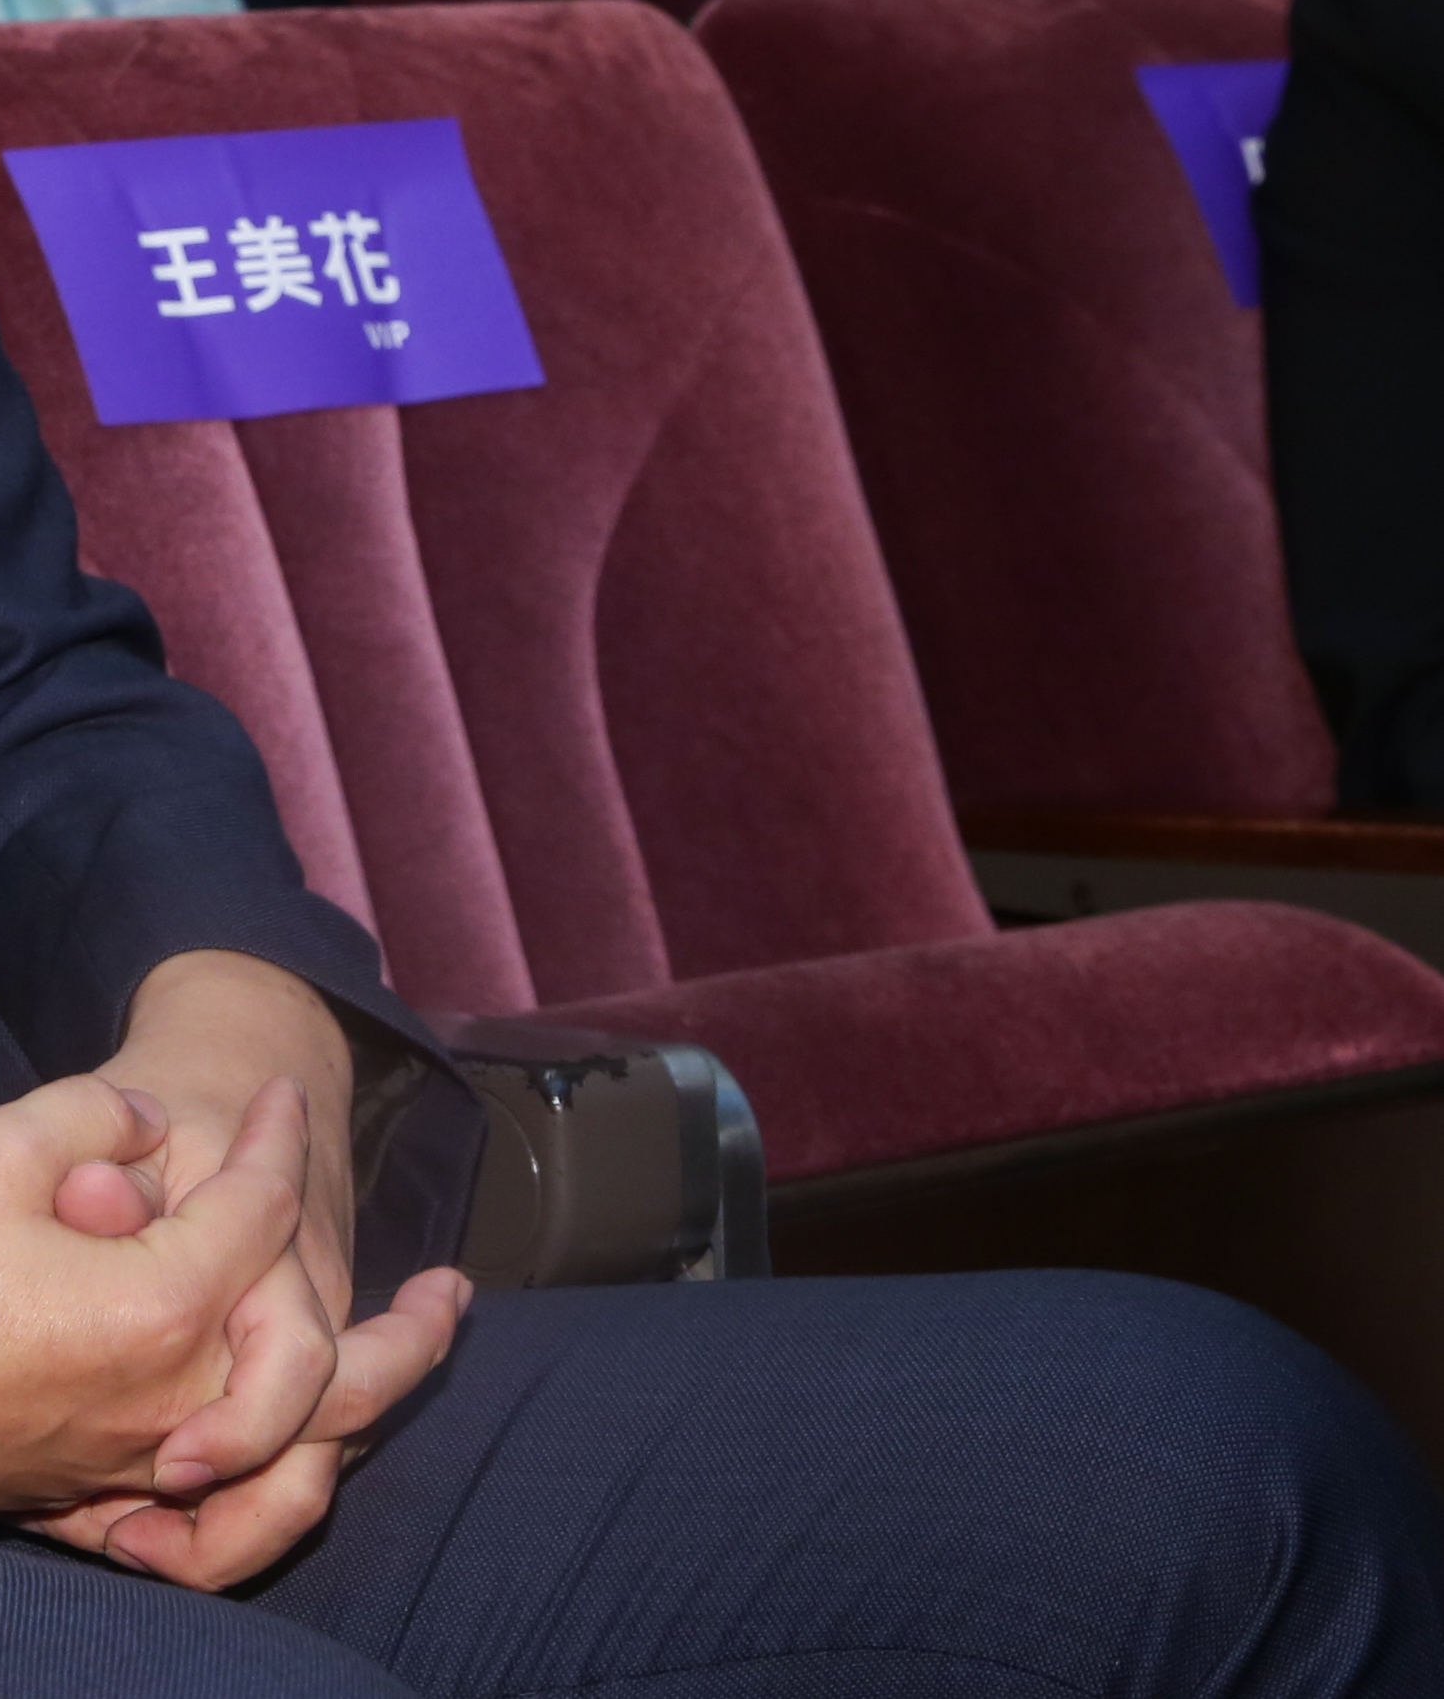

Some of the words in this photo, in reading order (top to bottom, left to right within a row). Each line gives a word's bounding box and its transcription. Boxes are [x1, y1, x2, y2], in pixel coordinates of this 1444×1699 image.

[138, 210, 401, 317] 王美花
[363, 320, 411, 350] VIP
